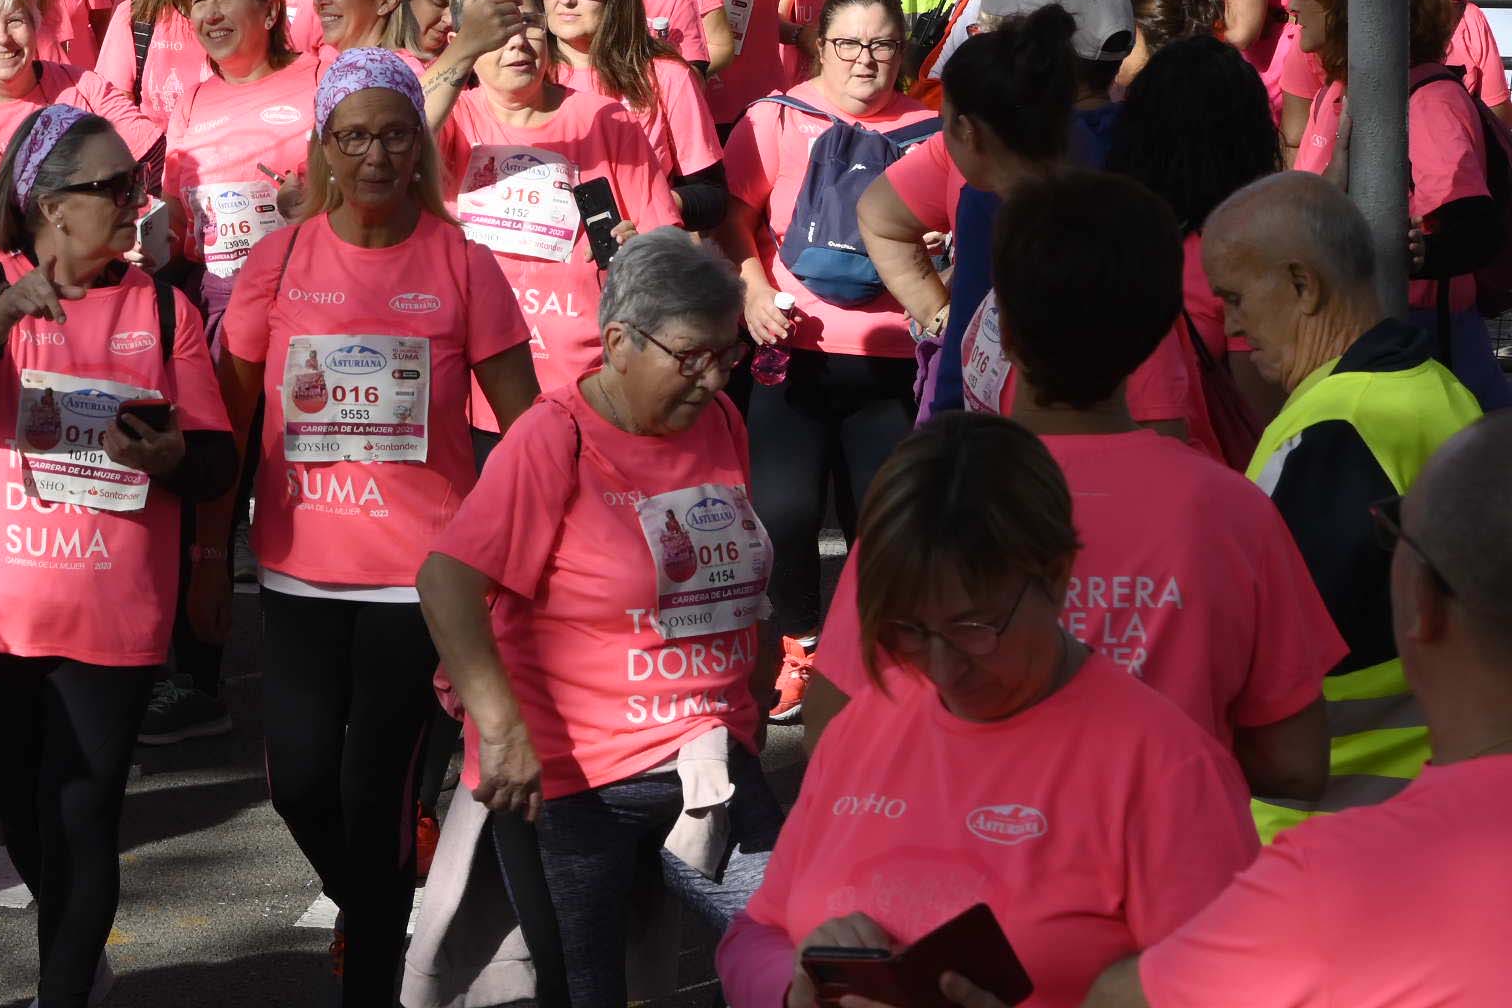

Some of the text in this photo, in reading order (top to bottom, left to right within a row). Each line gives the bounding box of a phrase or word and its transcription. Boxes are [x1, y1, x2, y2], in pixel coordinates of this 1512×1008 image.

[151, 40, 184, 51] OYSHO
[504, 207, 530, 218] 4152
[220, 220, 251, 236] 016
[471, 215, 501, 227] CARRERA
[501, 218, 513, 228] DE
[512, 221, 523, 230] LA
[548, 227, 565, 238] 2023
[288, 288, 346, 304] OYSHO
[393, 299, 438, 309] ASTURIANA
[109, 339, 155, 352] ASTURIANA
[330, 356, 382, 369] ASTURIANA
[971, 345, 990, 374] 016
[331, 385, 380, 404] 016
[340, 408, 370, 420] 9553
[300, 425, 339, 433] CARRERA
[340, 425, 352, 433] DE
[365, 426, 393, 434] MUJER
[296, 441, 419, 452] OYSHO Santander
[68, 448, 104, 465] 10101
[29, 461, 67, 472] CARRERA
[67, 466, 79, 474] DE
[81, 468, 91, 476] LA
[93, 470, 122, 481] MUJER
[23, 477, 65, 490] OYSHO
[99, 488, 141, 501] Santander
[286, 468, 385, 506] SUMA
[369, 509, 391, 518] 2023
[691, 506, 733, 526] ASTURIANA
[6, 523, 110, 558] SUMA
[699, 541, 740, 565] 016
[38, 560, 49, 568] DE
[49, 561, 58, 569] LA
[58, 562, 85, 571] MUJER
[708, 569, 735, 584] 4154
[671, 592, 710, 605] CARRERA
[710, 591, 723, 600] DE
[723, 590, 734, 599] LA
[668, 612, 713, 628] OYSHO
[1102, 613, 1147, 644] LA
[627, 632, 757, 681] DORSAL
[832, 793, 908, 819] OYHO
[978, 813, 1038, 835] ASTURIANA
